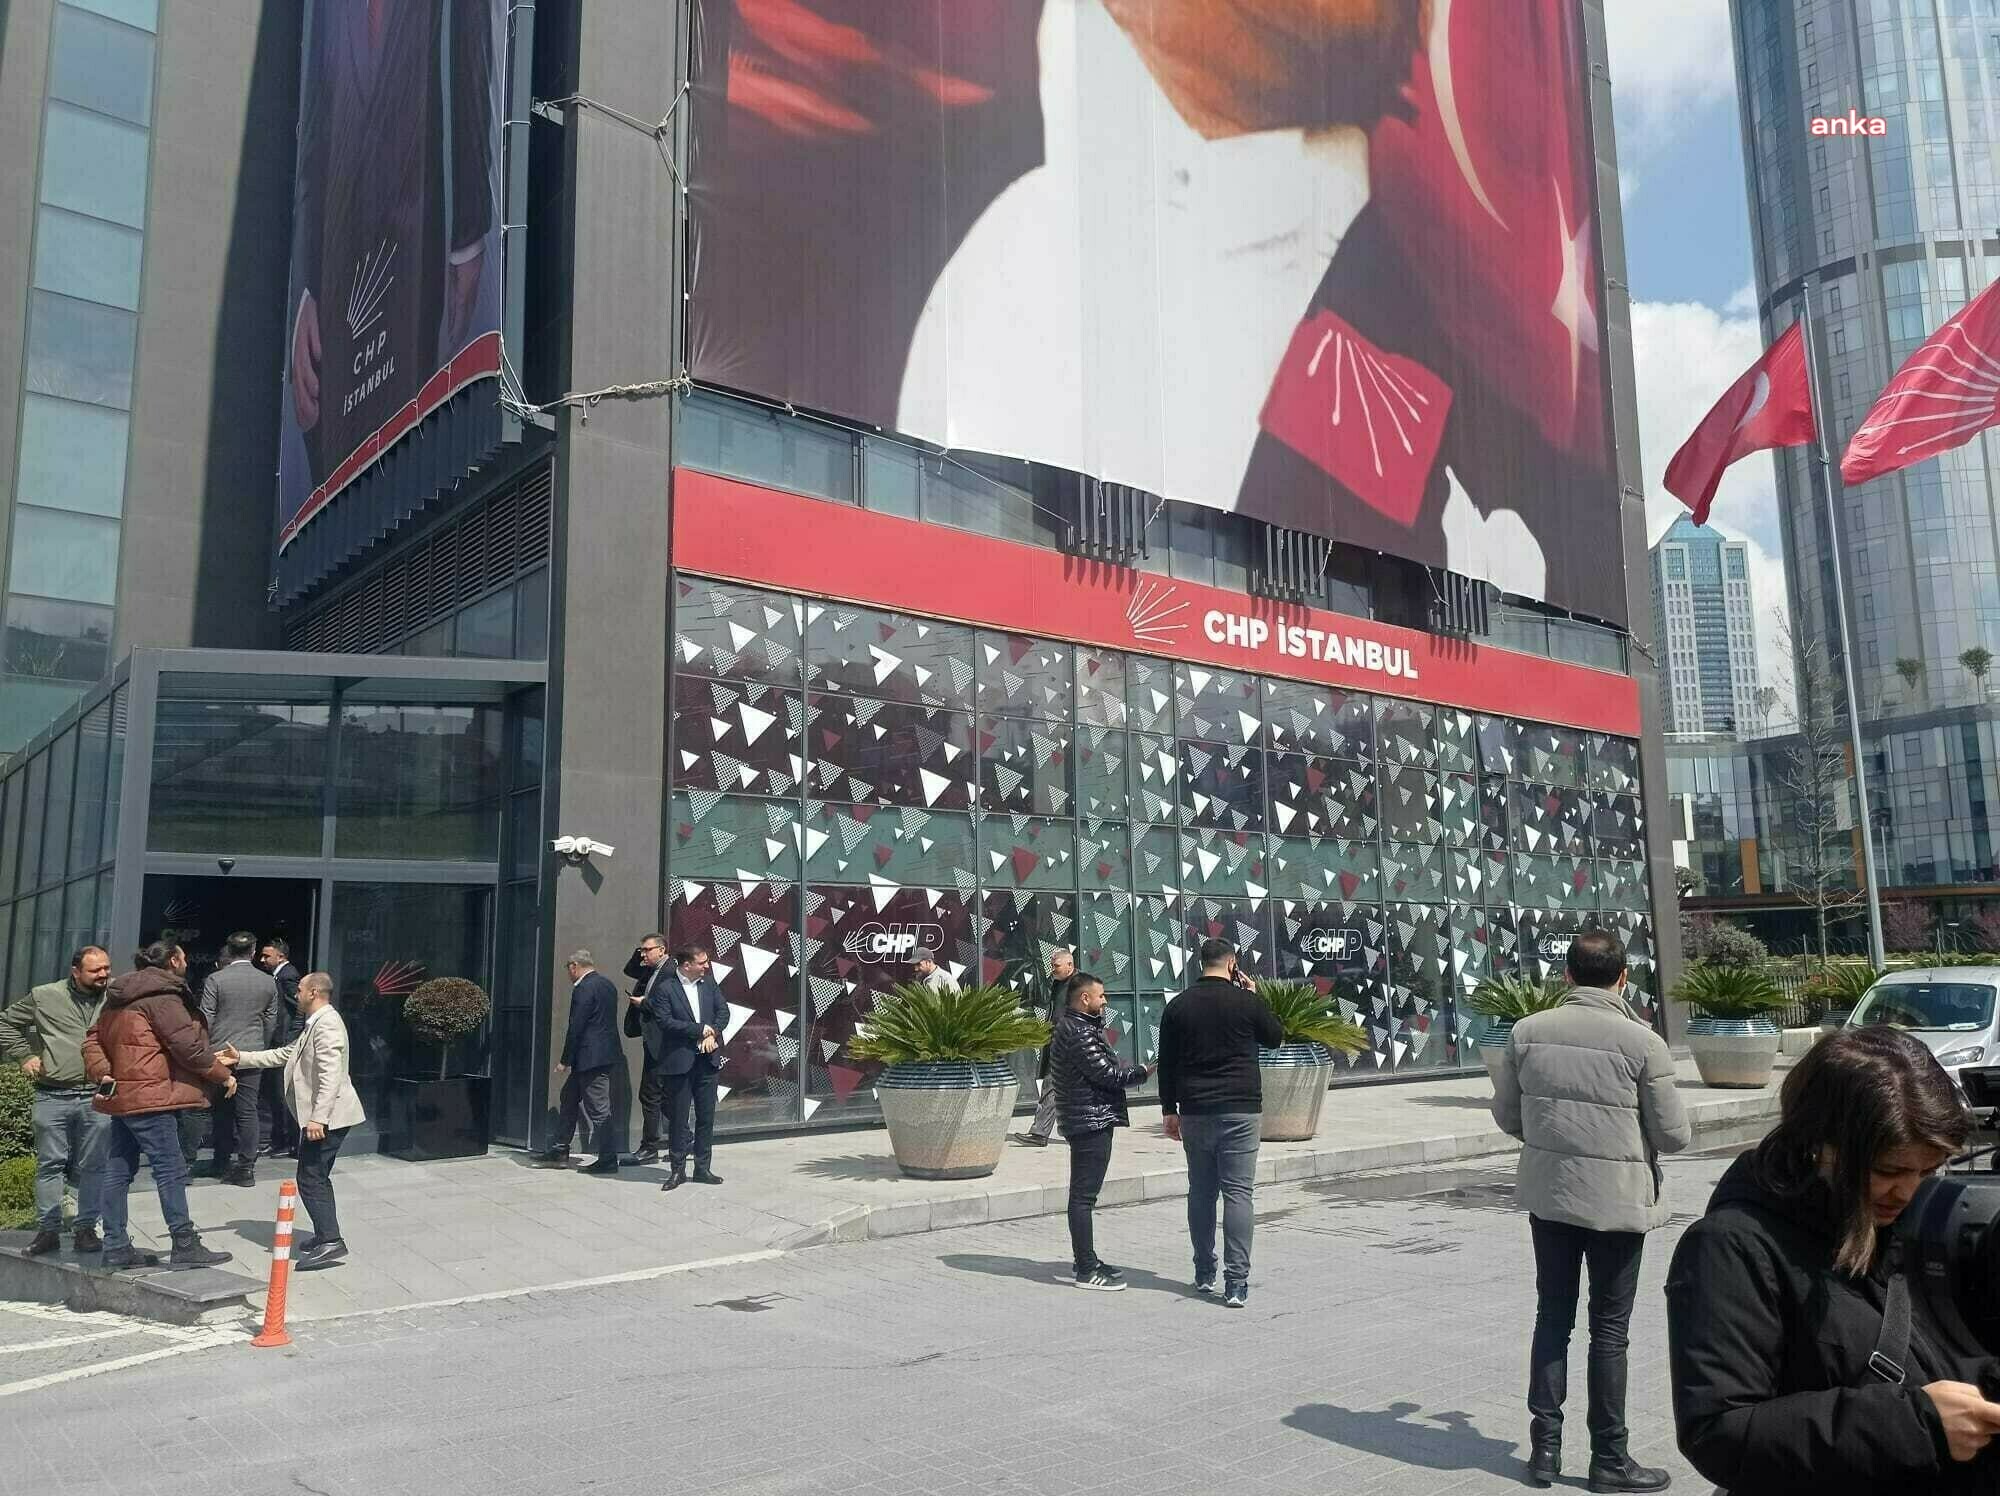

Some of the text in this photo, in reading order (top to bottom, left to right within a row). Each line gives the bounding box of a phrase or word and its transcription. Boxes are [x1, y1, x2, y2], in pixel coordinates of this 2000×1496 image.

[353, 330, 386, 375] CHP
[343, 355, 395, 416] İSTANBUL
[1203, 610, 1419, 679] CHP İSTANBUL
[872, 933, 916, 953] CHP
[1318, 936, 1345, 952] CHP
